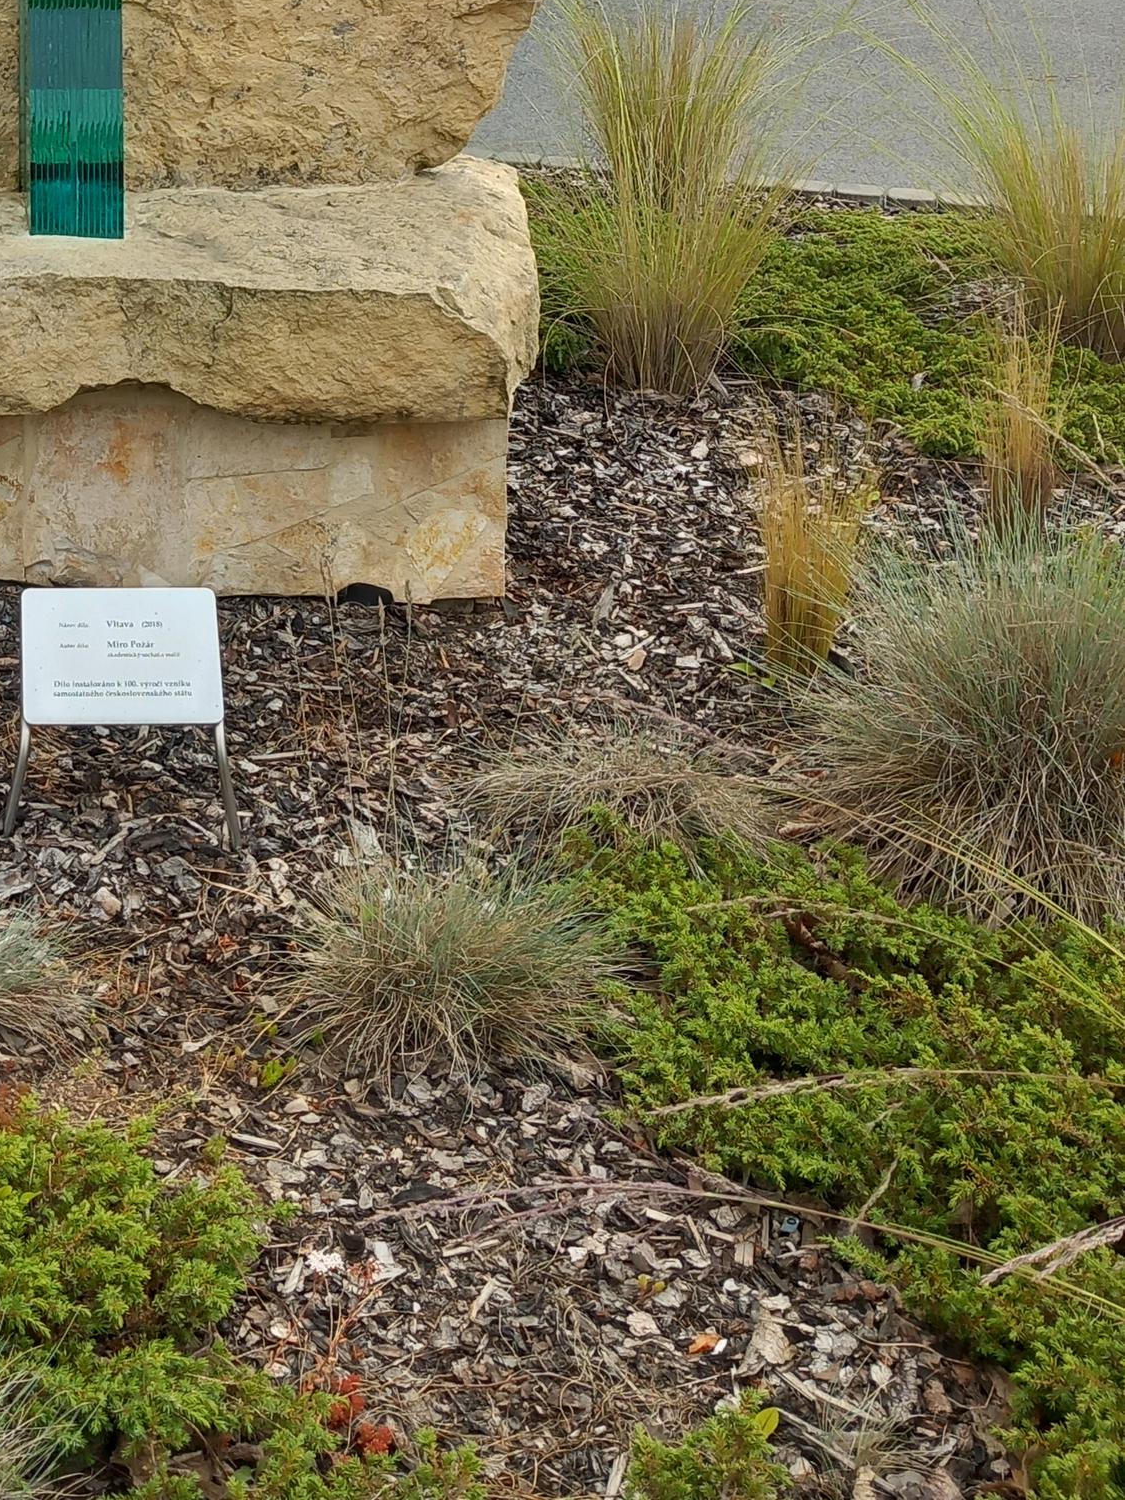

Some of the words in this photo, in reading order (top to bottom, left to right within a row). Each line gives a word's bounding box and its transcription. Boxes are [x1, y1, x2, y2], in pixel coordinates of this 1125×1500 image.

[106, 620, 134, 628] Vltava
[107, 640, 129, 649] Miro
[54, 680, 71, 688] Dílo
[72, 680, 116, 688] instalováno
[117, 680, 122, 688] k
[164, 680, 192, 688] vzniku
[174, 689, 193, 697] státu
